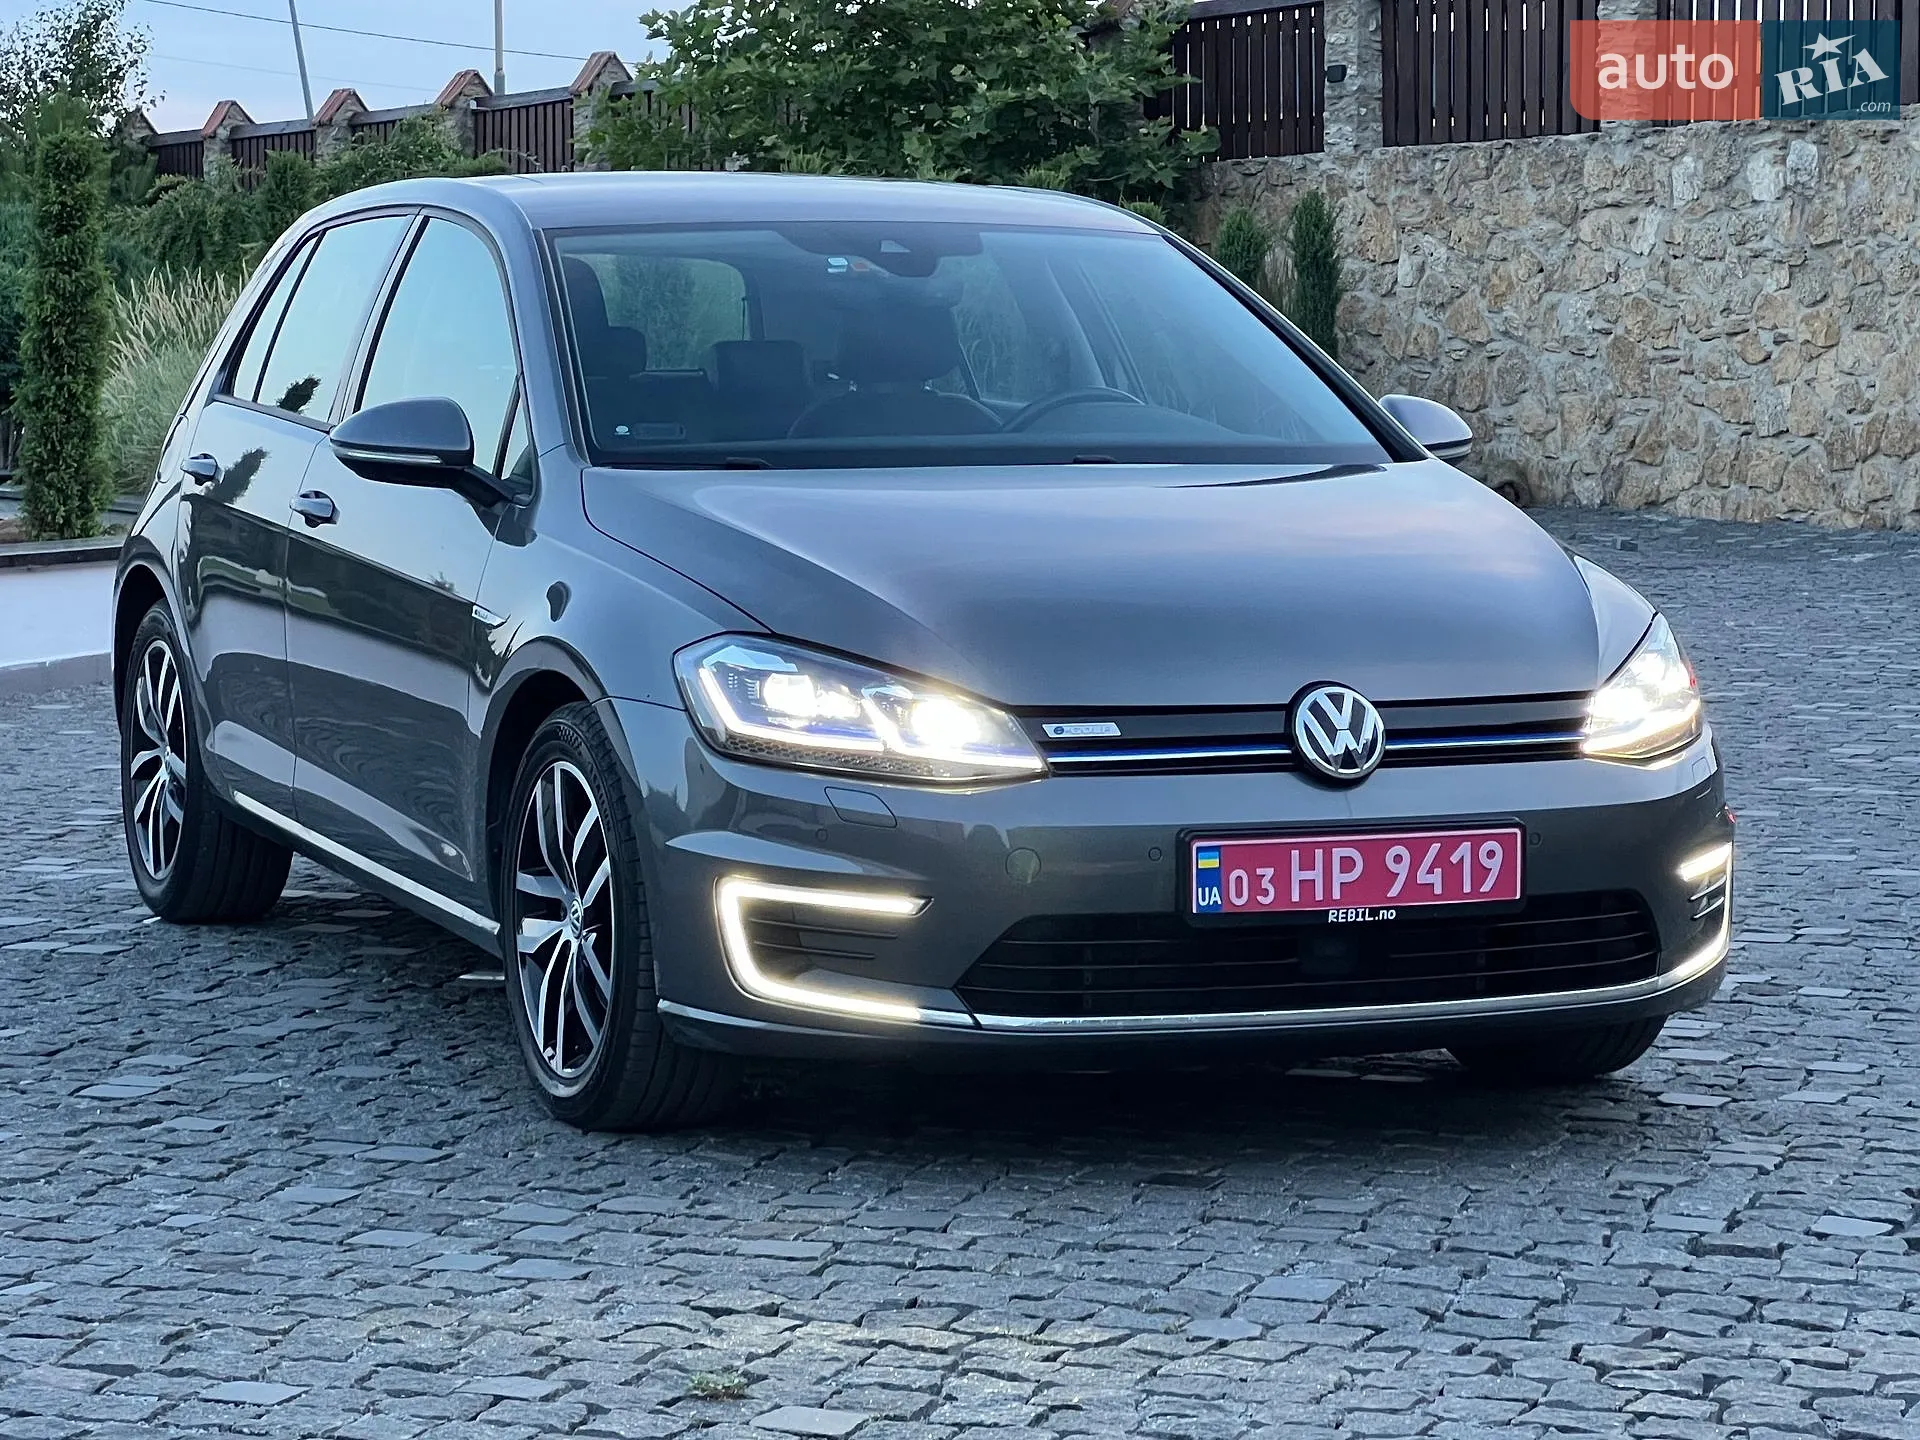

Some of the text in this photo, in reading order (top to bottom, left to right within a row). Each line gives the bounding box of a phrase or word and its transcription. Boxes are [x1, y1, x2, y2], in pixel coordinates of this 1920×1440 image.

[1229, 840, 1504, 906] 03 HP 9419
[1198, 887, 1222, 906] UA
[1328, 907, 1397, 923] REBIL.no
